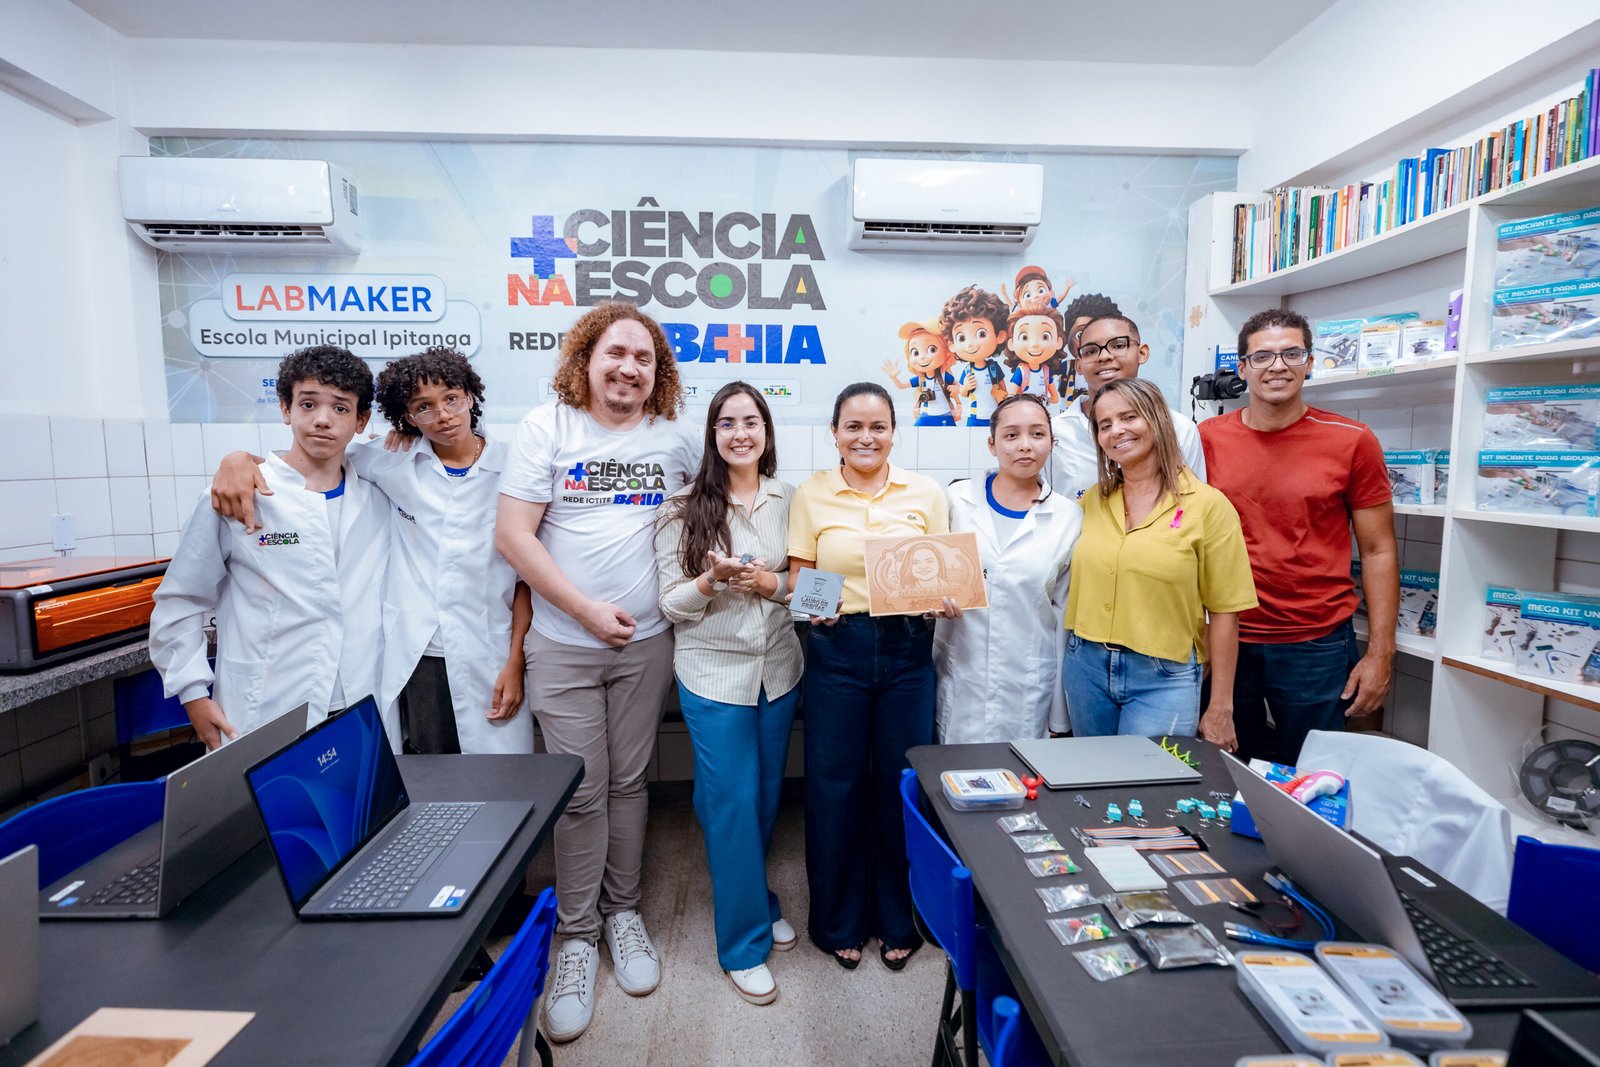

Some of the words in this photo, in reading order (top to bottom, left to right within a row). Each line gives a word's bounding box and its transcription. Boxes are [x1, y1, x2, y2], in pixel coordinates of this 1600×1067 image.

[1514, 219, 1555, 231] INICIANTE
[1557, 215, 1580, 223] PARA
[1511, 286, 1551, 297] INICIANTE
[1553, 283, 1577, 292] PARA
[235, 284, 433, 313] LABMAKER
[200, 328, 267, 346] Escola
[274, 328, 377, 349] Municipal
[383, 329, 471, 349] Ipitanga
[587, 477, 667, 492] ESCOLA
[562, 496, 584, 504] REDE
[1404, 574, 1417, 582] KIT
[1418, 576, 1436, 584] UNO
[1492, 591, 1520, 600] MEGA
[1527, 603, 1560, 614] MEGA
[1562, 608, 1581, 616] KIT
[317, 747, 337, 767] 14:54
